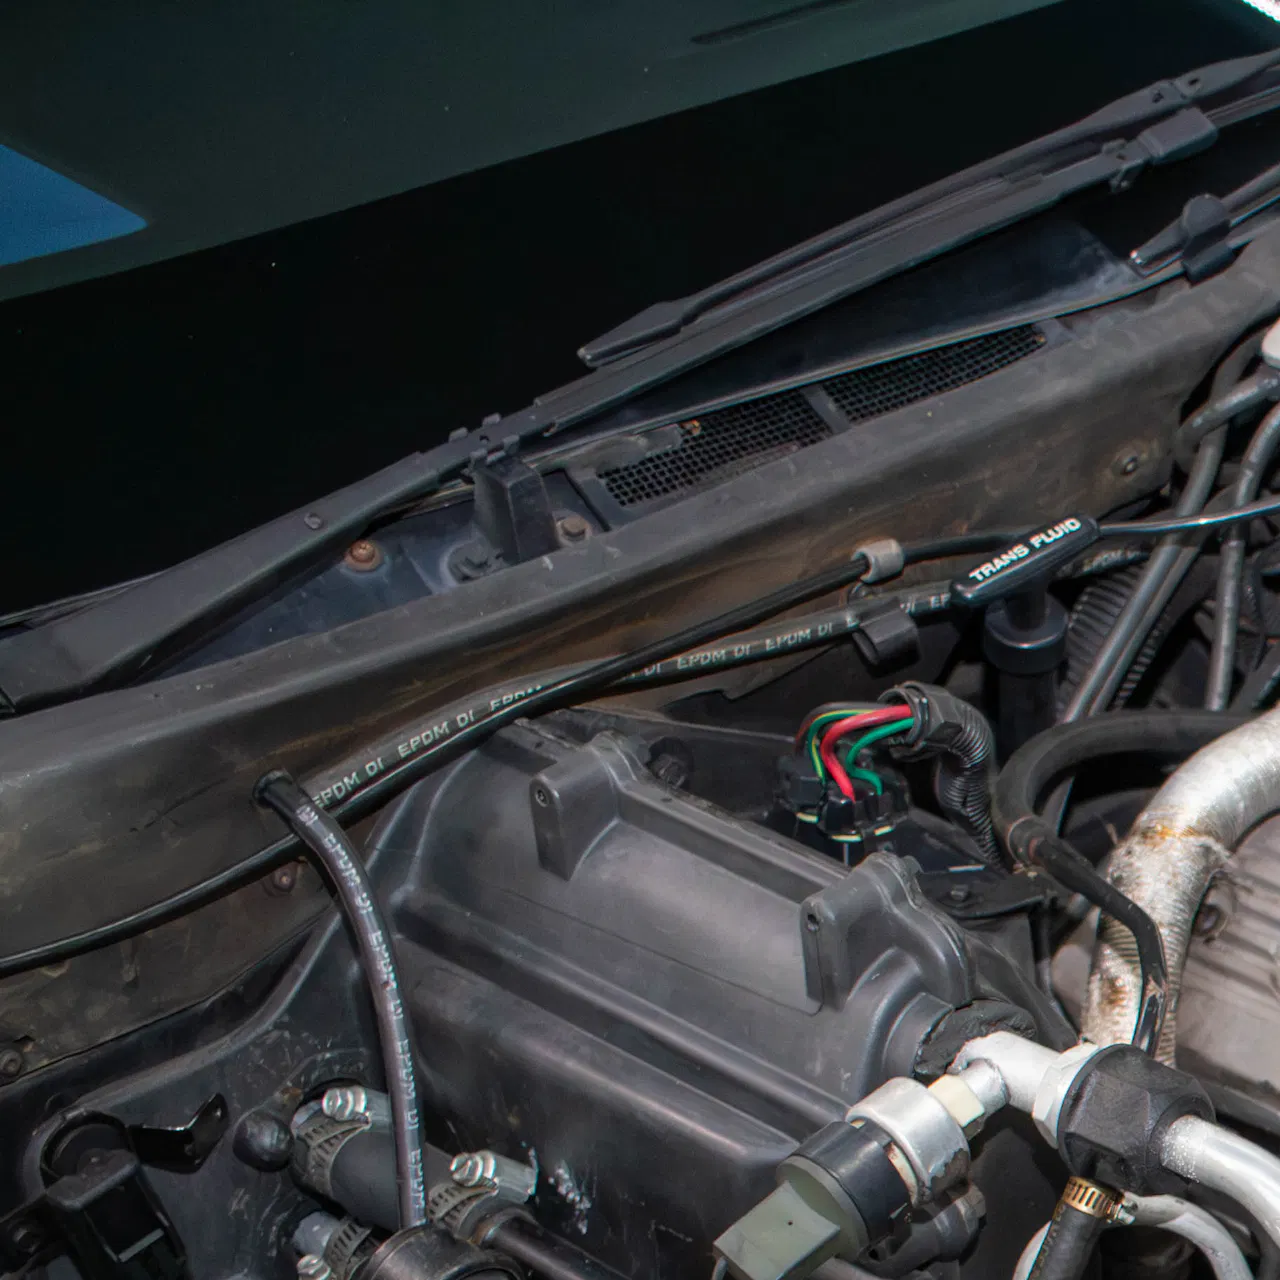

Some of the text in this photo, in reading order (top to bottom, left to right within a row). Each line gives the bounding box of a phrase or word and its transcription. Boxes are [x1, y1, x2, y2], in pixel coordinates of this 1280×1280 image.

[968, 517, 1081, 582] TRANS FLUID
[398, 722, 449, 758] EPDM
[457, 709, 475, 728] DI
[677, 649, 726, 671] EPDM
[765, 628, 812, 650] EPDM
